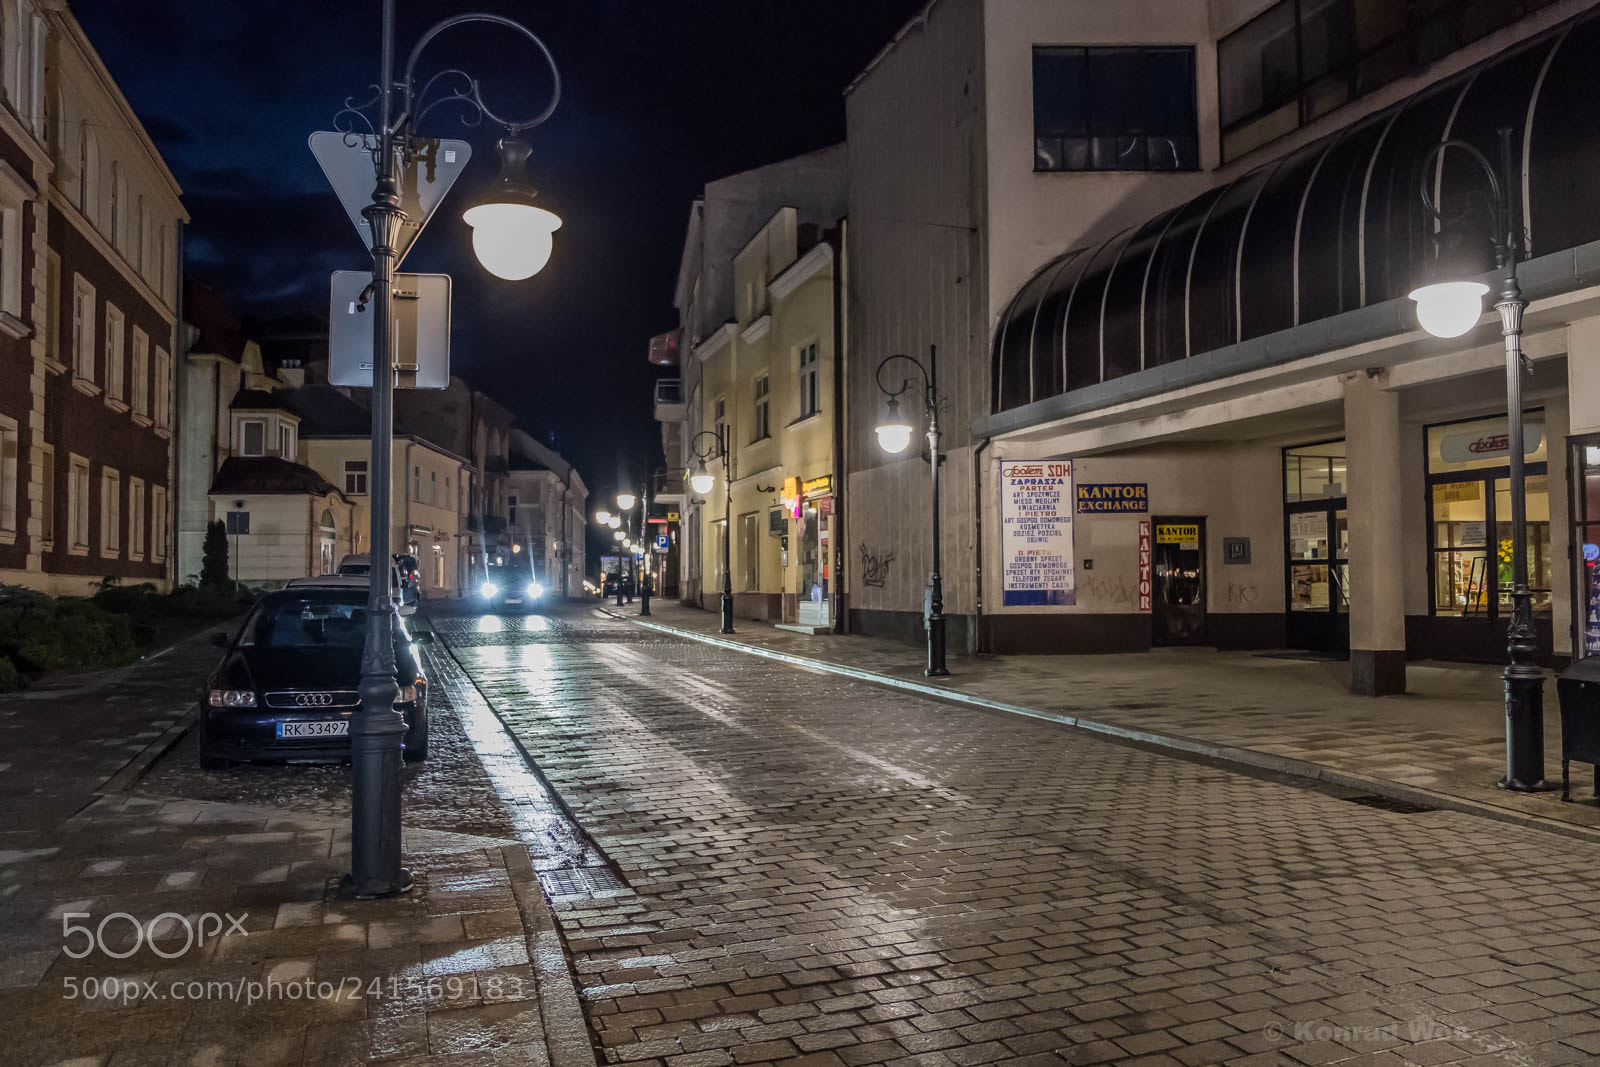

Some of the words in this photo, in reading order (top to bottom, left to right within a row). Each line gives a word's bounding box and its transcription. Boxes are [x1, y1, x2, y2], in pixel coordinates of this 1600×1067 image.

[1079, 486, 1146, 498] KANTOR
[1079, 501, 1146, 510] EXCHANGE
[1158, 527, 1196, 536] KANTOR
[659, 536, 666, 546] P
[1140, 523, 1150, 609] KANTOR
[284, 724, 303, 736] RK
[308, 723, 347, 735] 53497
